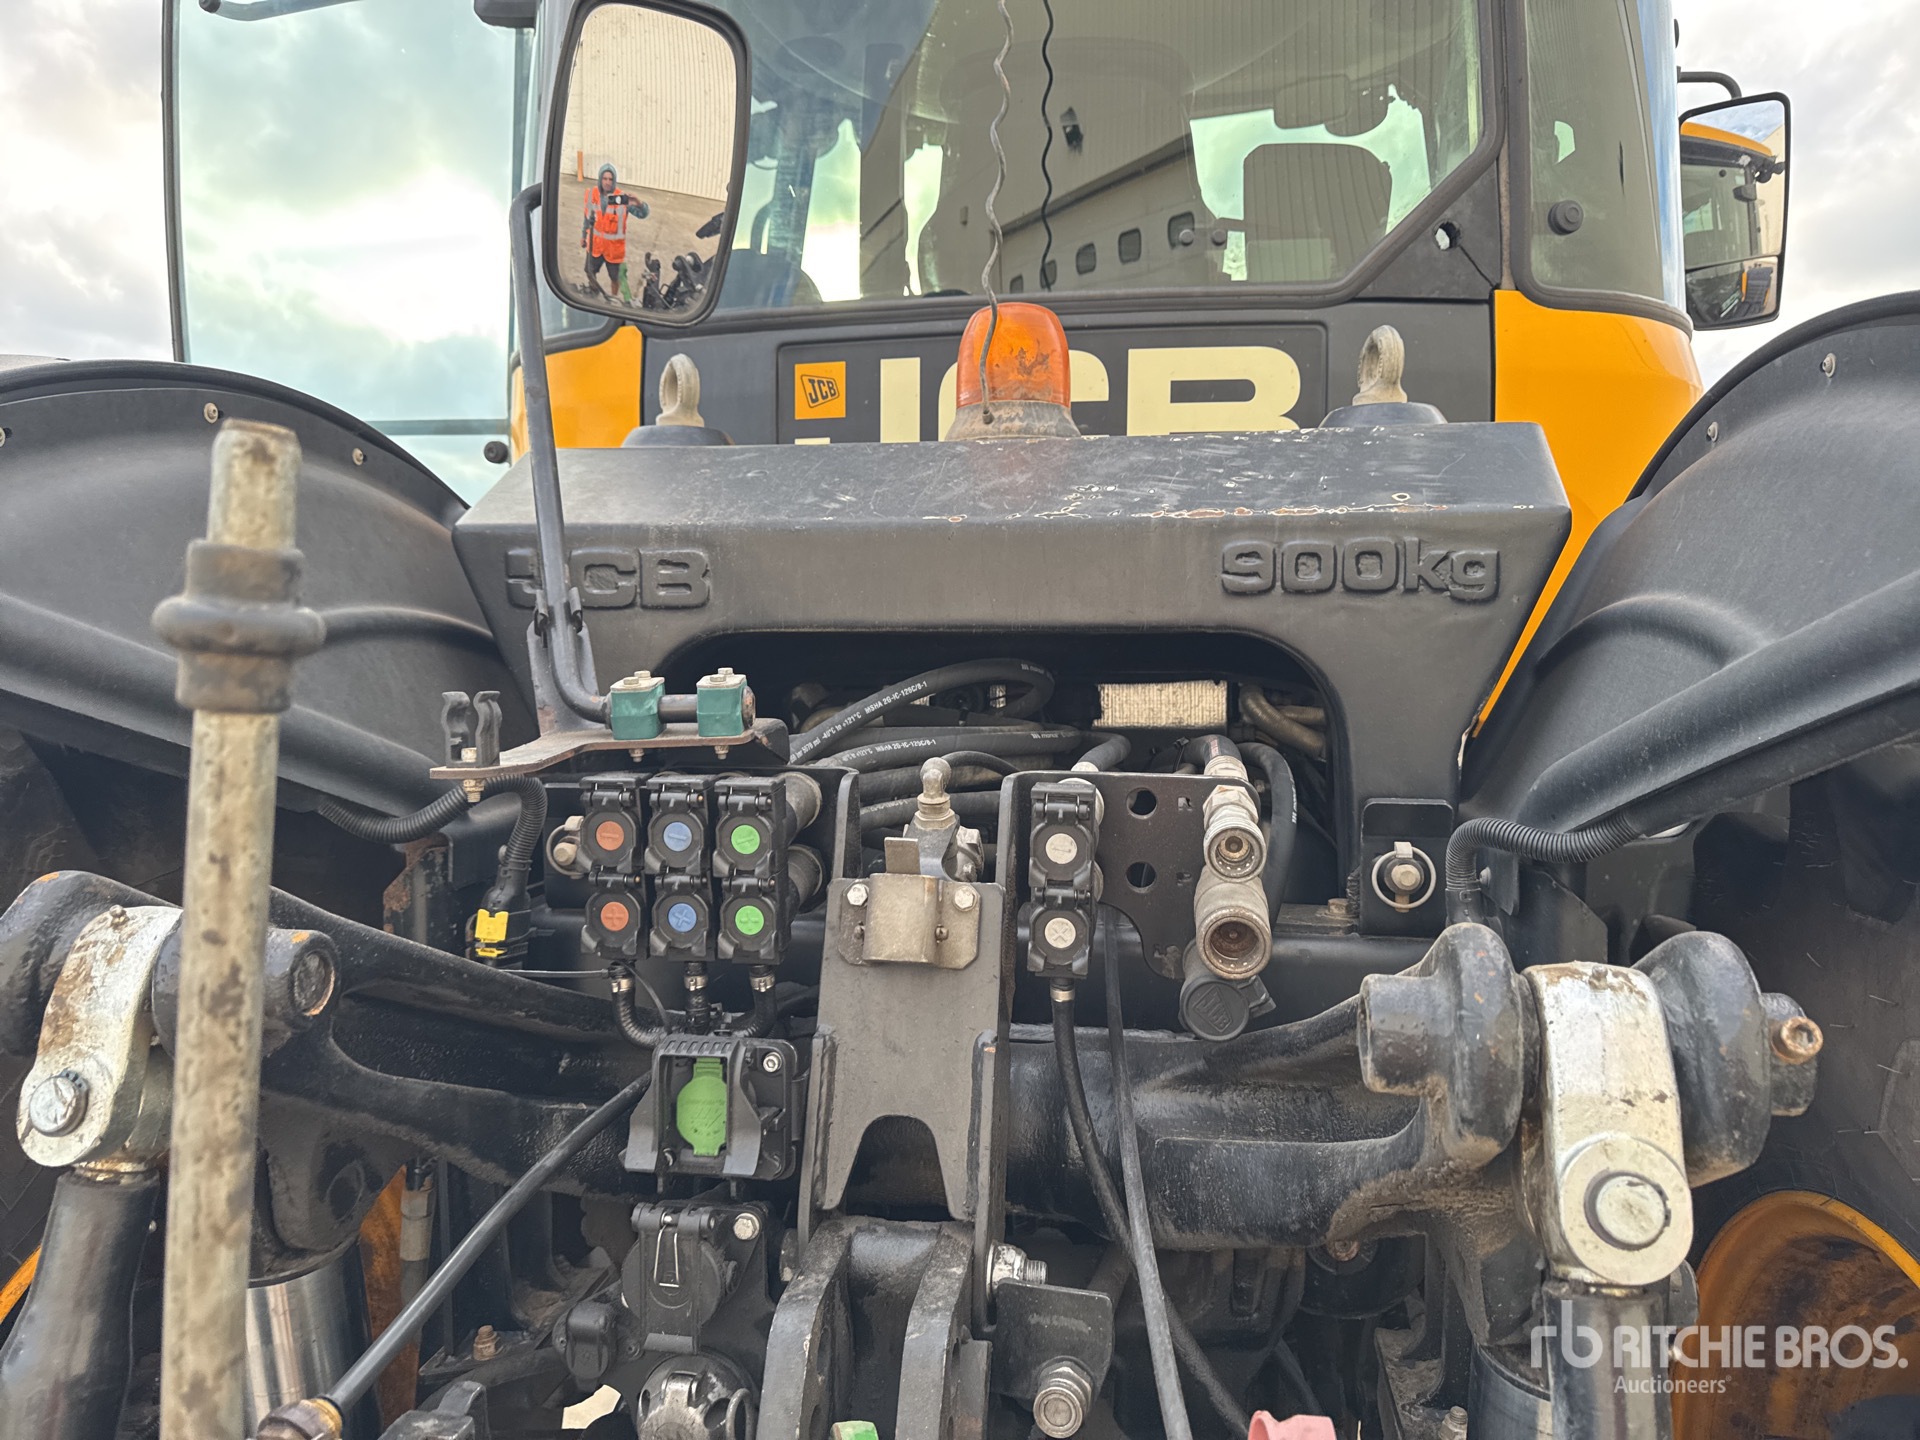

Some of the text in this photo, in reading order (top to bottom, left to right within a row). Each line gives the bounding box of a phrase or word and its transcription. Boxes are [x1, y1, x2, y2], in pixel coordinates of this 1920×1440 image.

[808, 378, 837, 404] JCB
[1221, 536, 1500, 602] 900kg
[864, 700, 884, 714] MSHA
